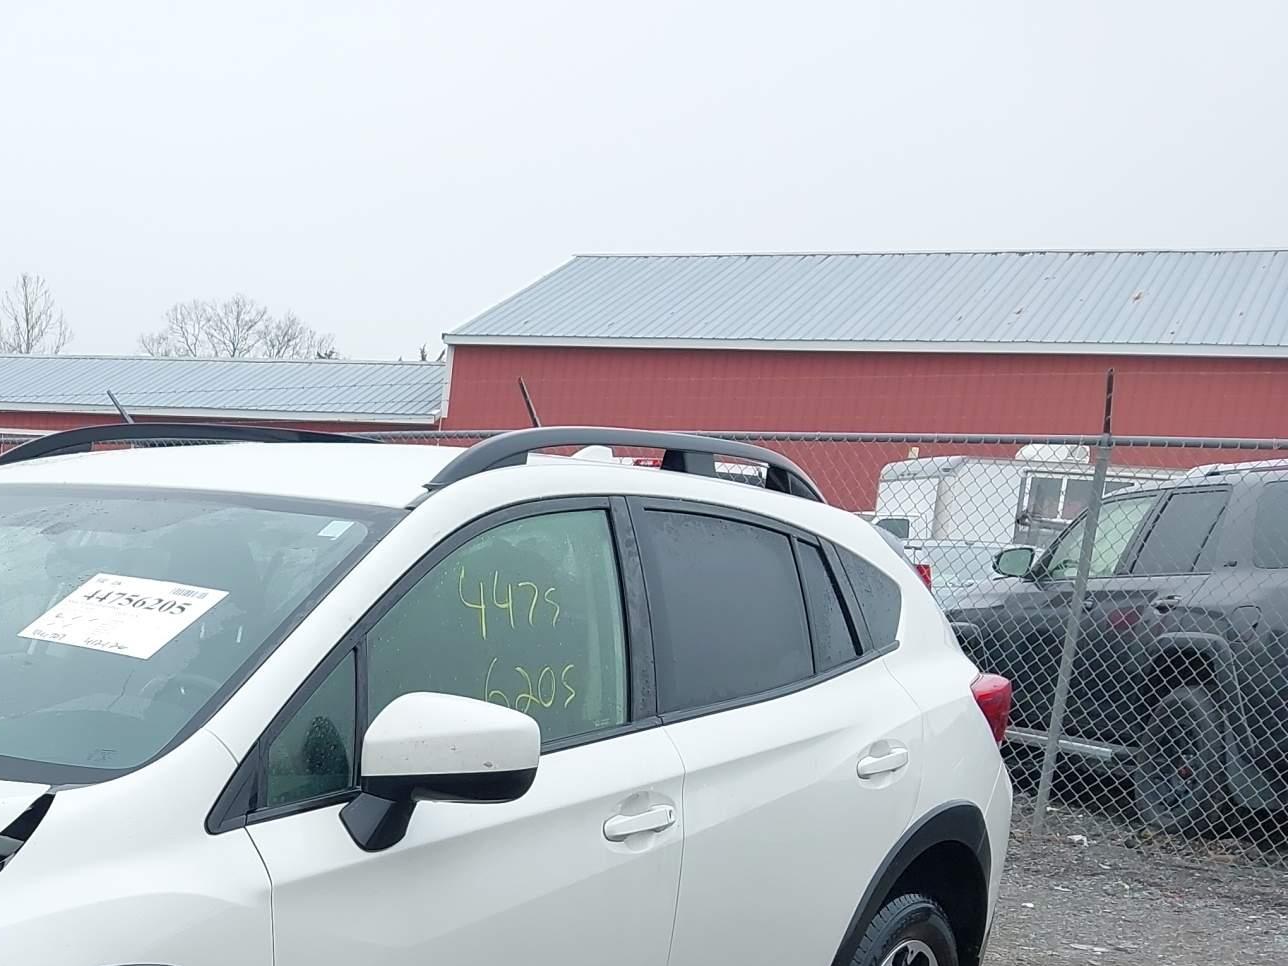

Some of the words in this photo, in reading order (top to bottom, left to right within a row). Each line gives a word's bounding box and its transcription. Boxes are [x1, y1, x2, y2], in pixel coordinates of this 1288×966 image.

[83, 588, 193, 616] 44756205
[459, 565, 560, 641] 4475
[484, 656, 576, 714] 6205
